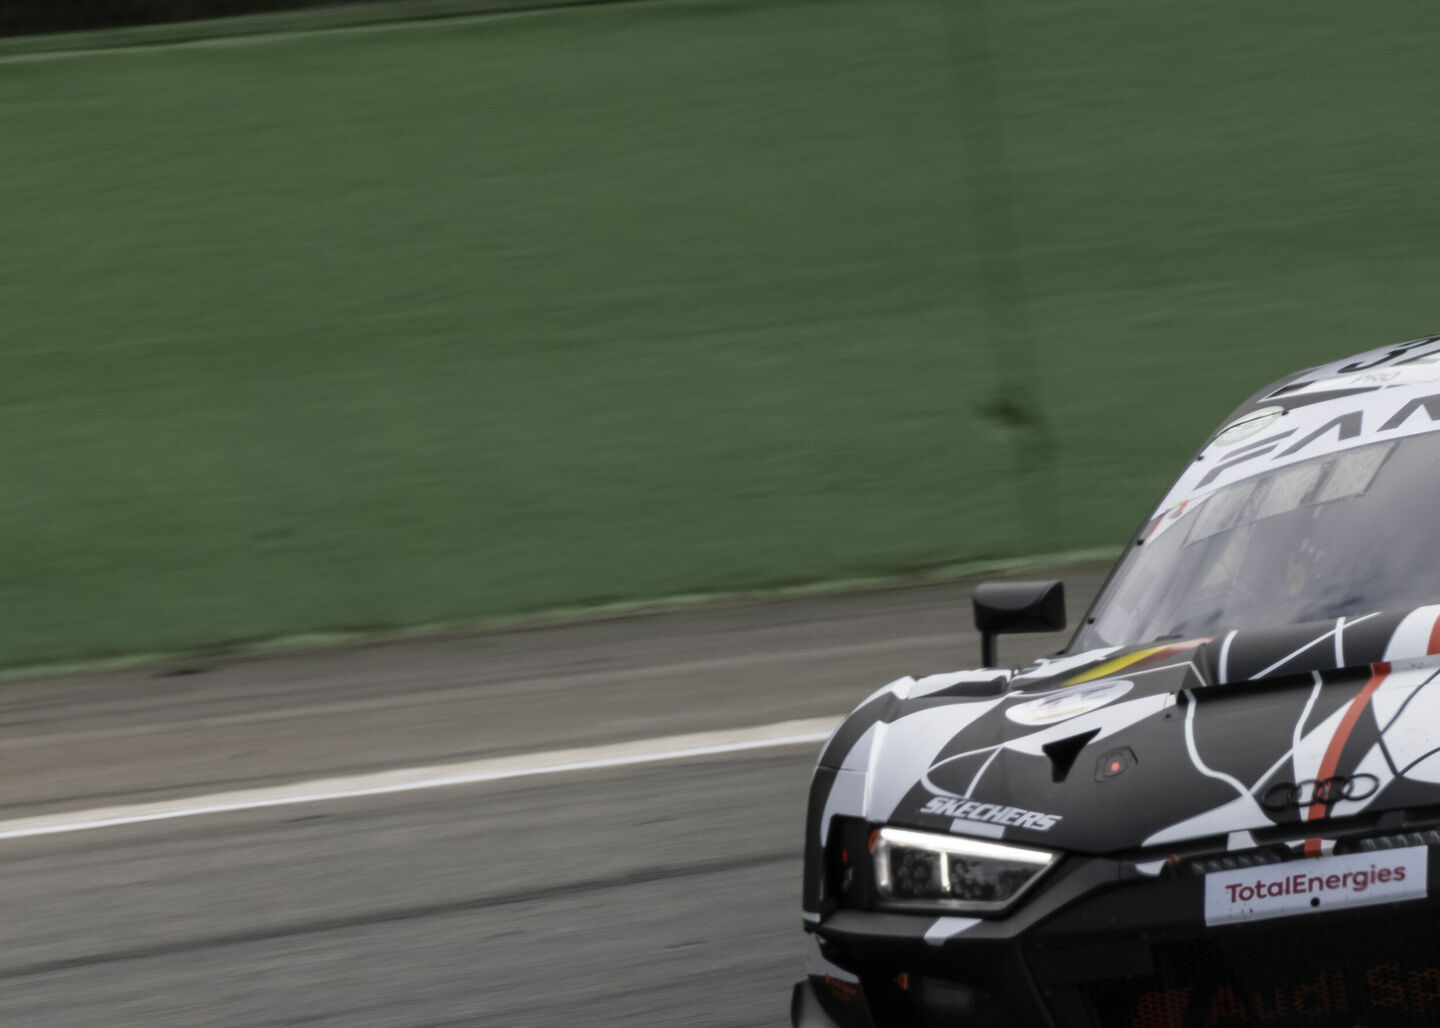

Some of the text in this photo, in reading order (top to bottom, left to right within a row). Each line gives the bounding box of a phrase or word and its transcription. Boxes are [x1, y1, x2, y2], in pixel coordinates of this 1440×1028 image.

[920, 797, 1064, 831] SKECHERS
[1225, 864, 1407, 903] TotalEnergies
[1206, 968, 1349, 1026] Audi
